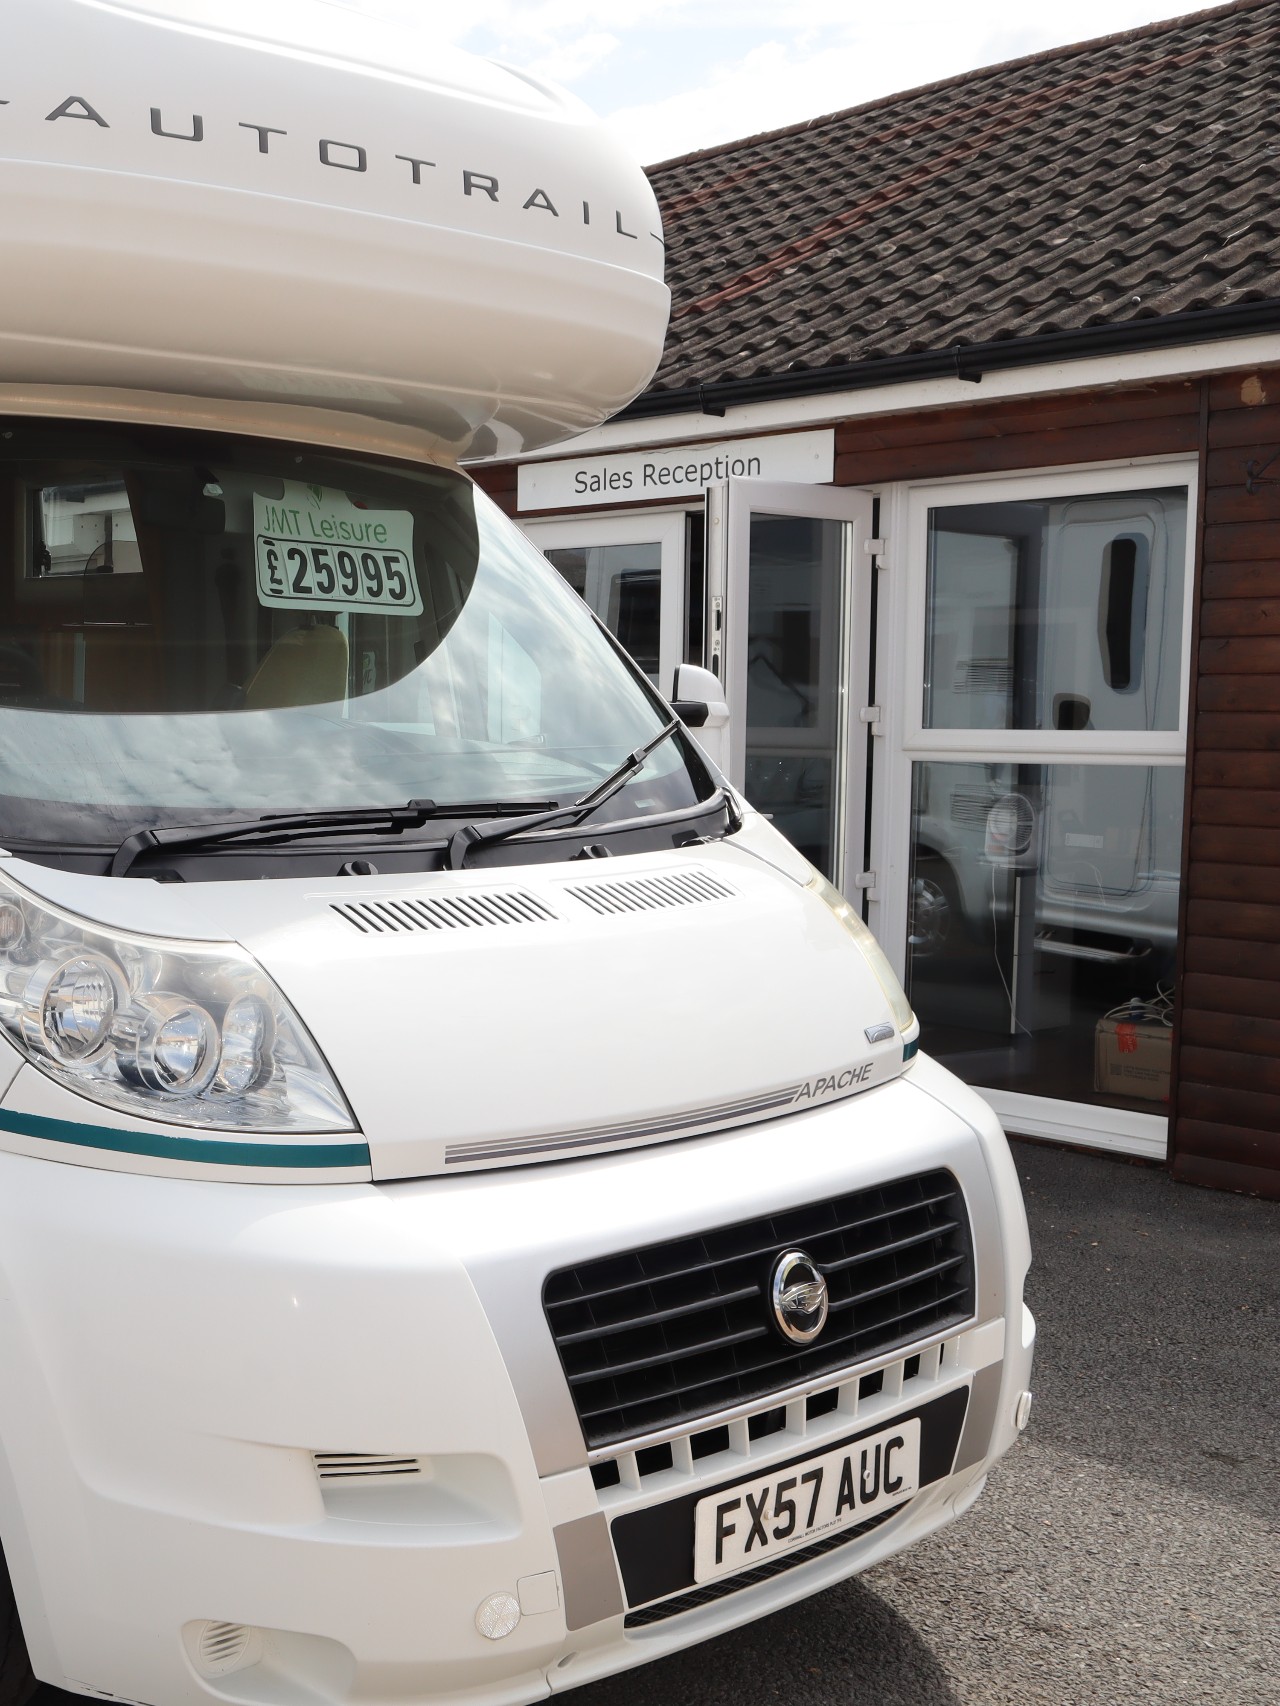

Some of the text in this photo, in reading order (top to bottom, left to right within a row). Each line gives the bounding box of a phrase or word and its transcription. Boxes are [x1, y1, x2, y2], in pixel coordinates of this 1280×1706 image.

[45, 95, 638, 240] AUTOTRAIL
[574, 455, 761, 493] Sales Reception
[264, 505, 388, 543] JMT Leisure
[795, 1062, 874, 1103] APACHE
[715, 1436, 905, 1565] FX57 AUC
